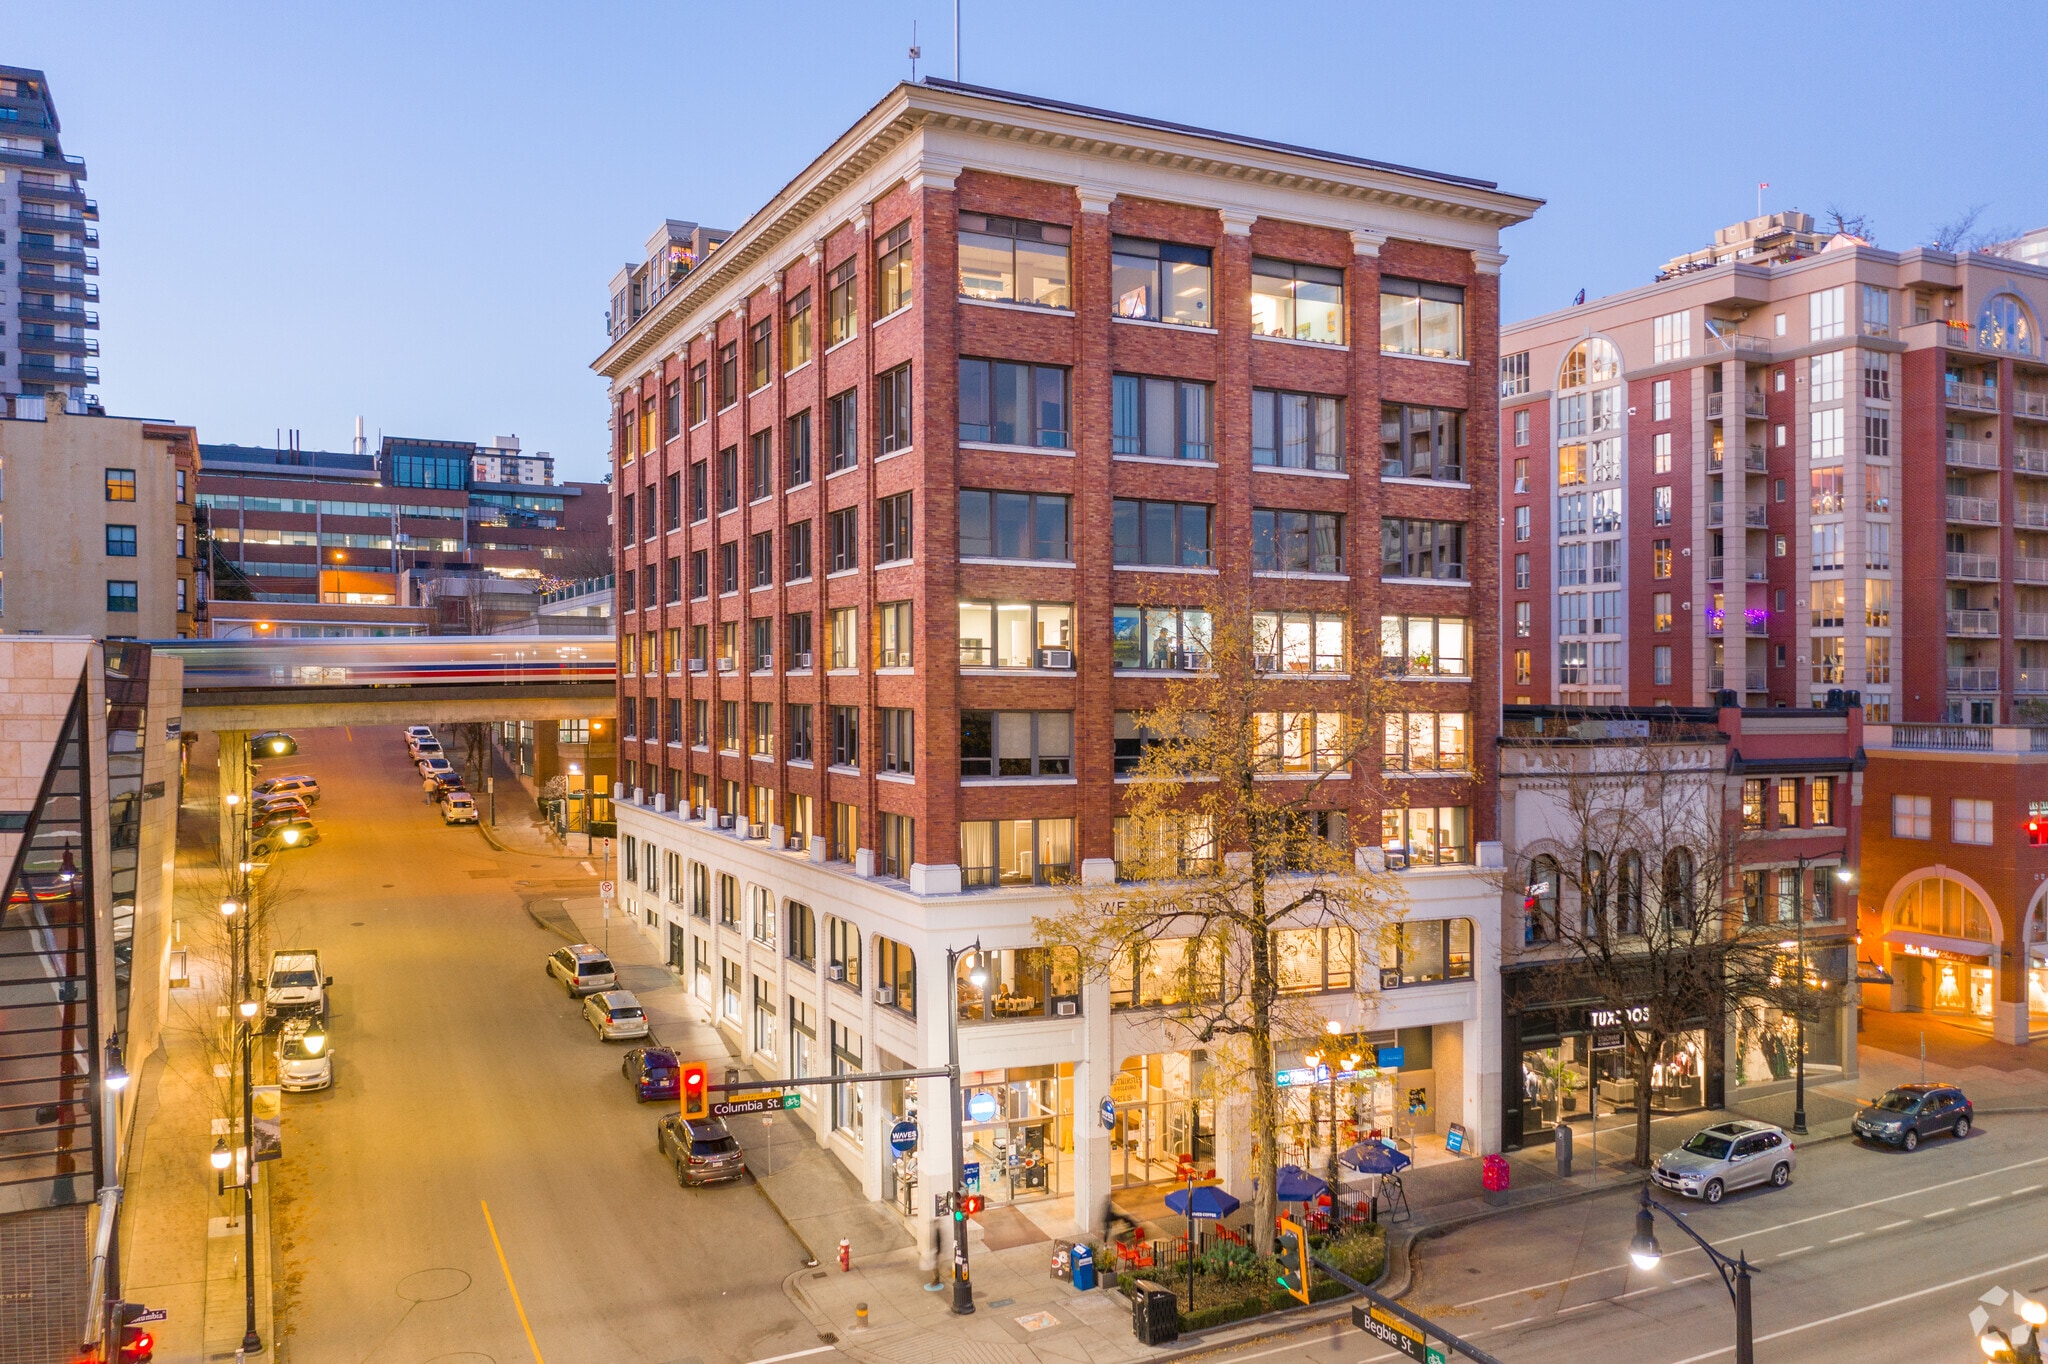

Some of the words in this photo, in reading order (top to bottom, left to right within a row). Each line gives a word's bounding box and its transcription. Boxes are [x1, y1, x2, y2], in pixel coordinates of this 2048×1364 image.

[1303, 887, 1372, 902] BUDNG
[1100, 896, 1227, 915] WEMINSTER
[714, 1100, 763, 1114] Columbia
[767, 1098, 781, 1109] St.
[892, 1130, 918, 1139] WAVES
[1364, 1314, 1398, 1345] Begbie
[1401, 1335, 1415, 1355] St.
